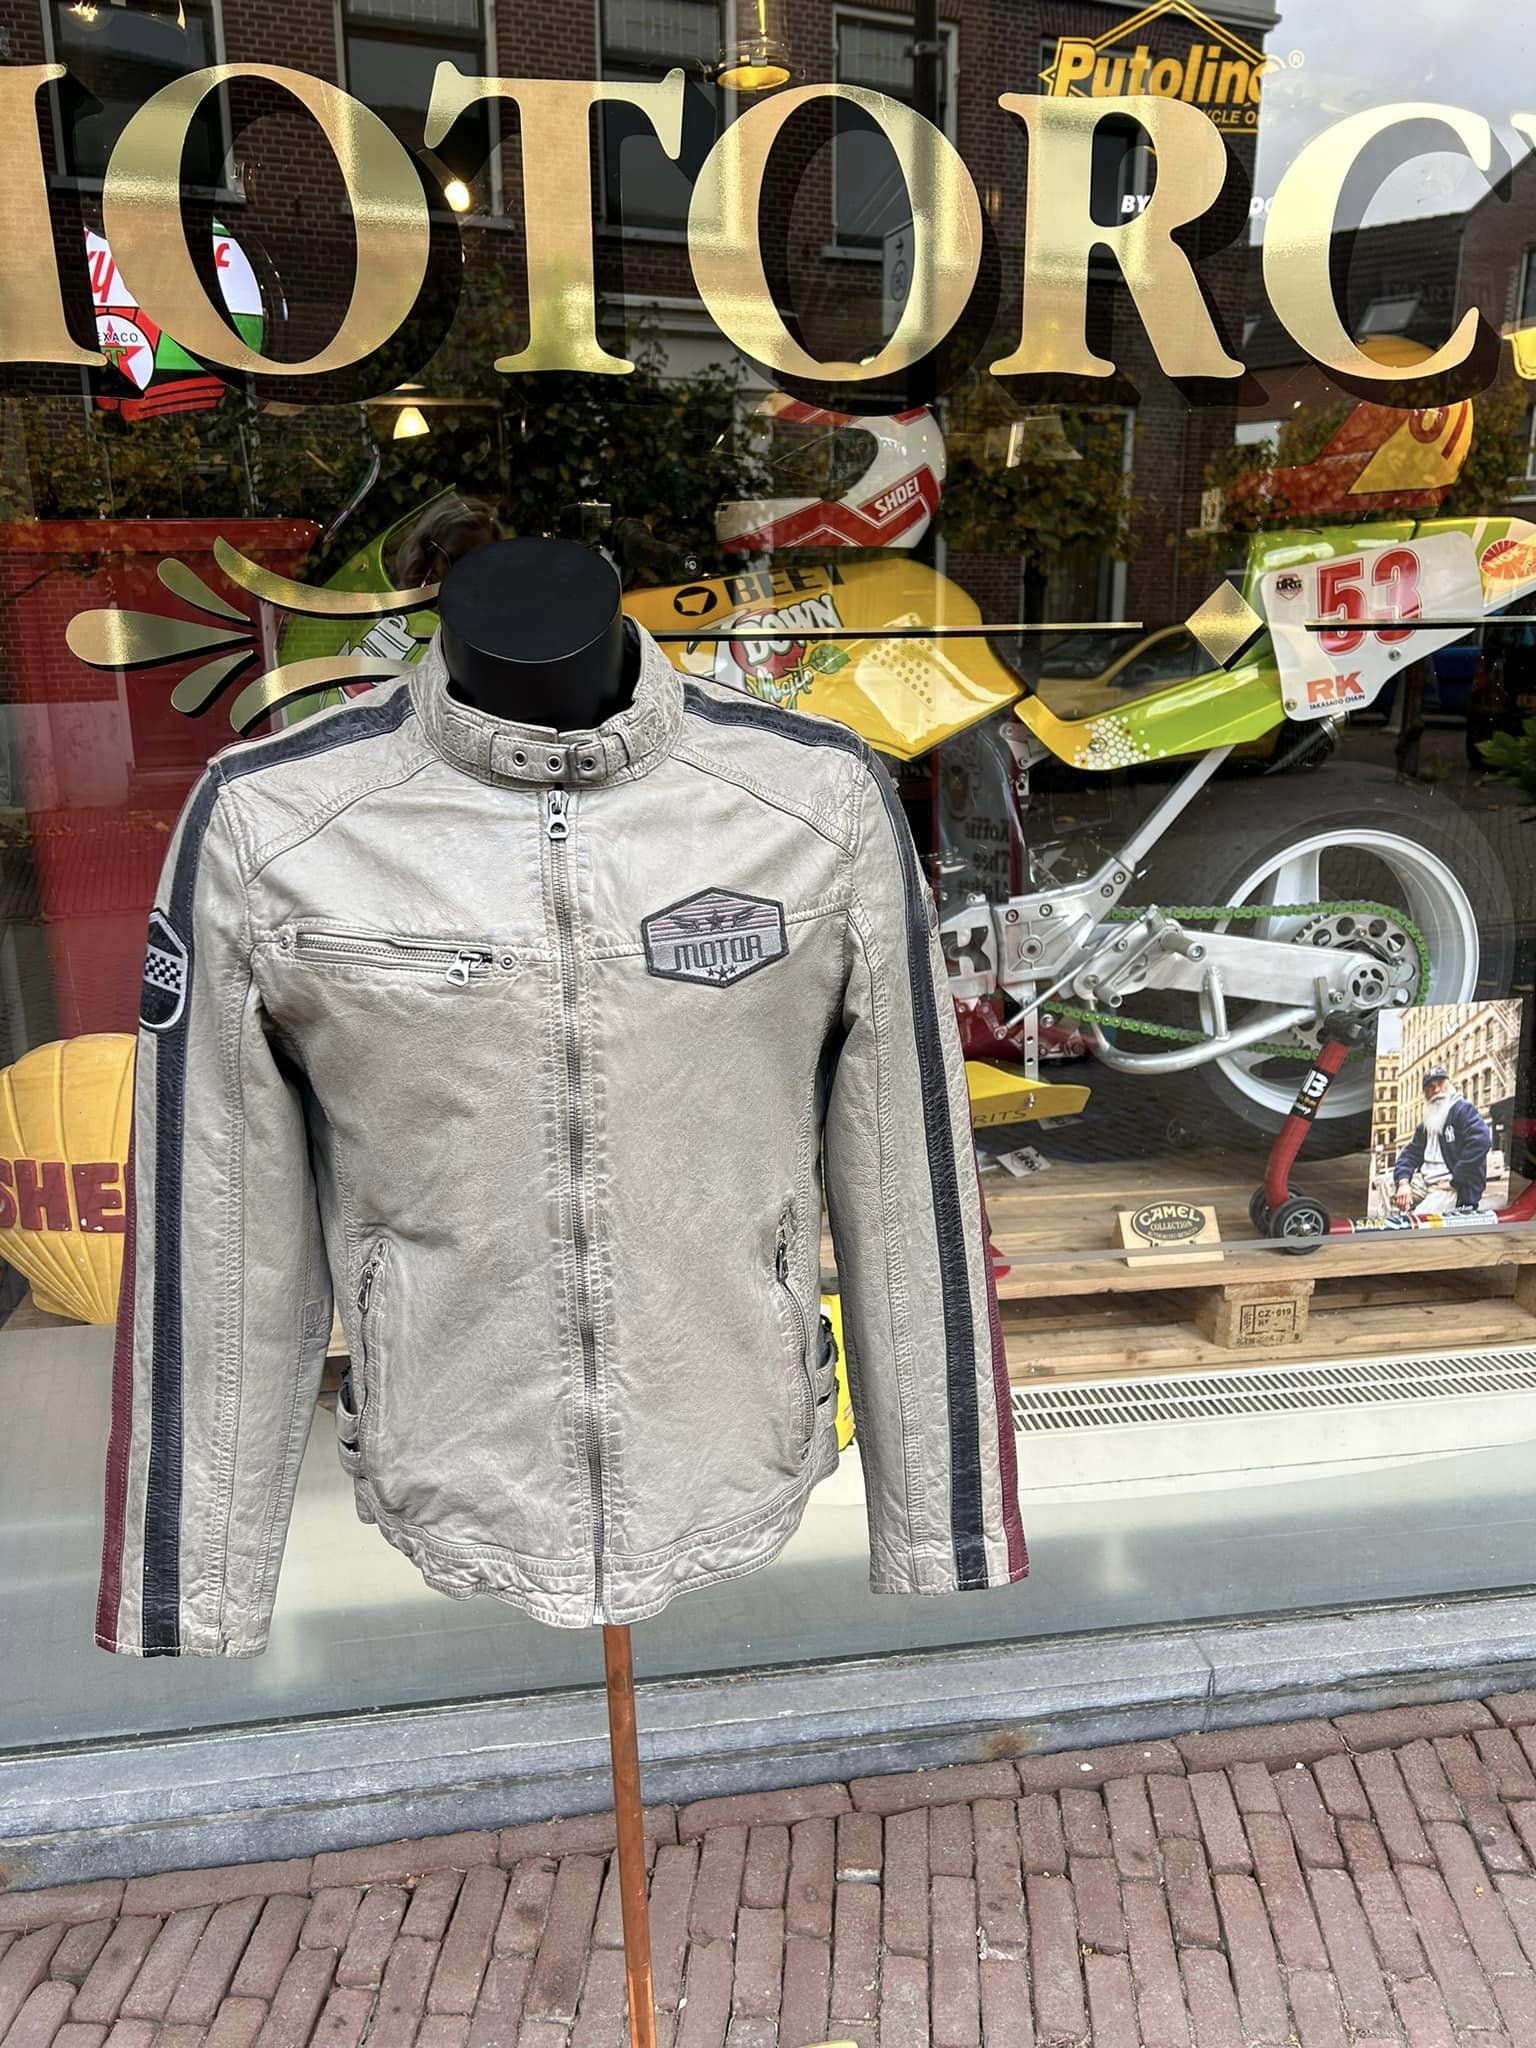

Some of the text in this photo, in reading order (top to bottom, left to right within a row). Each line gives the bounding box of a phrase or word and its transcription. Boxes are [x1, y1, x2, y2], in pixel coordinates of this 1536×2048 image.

[0, 60, 1536, 382] OTORC
[97, 331, 139, 343] EXACO
[874, 476, 920, 517] SHOEI
[1317, 547, 1423, 656] 53
[737, 594, 844, 664] DOWN
[1306, 671, 1364, 703] RK
[674, 934, 769, 972] MOTOR
[0, 1157, 127, 1233] HE
[1139, 1205, 1200, 1227] CAMEL
[1150, 1220, 1194, 1232] COLLECTION
